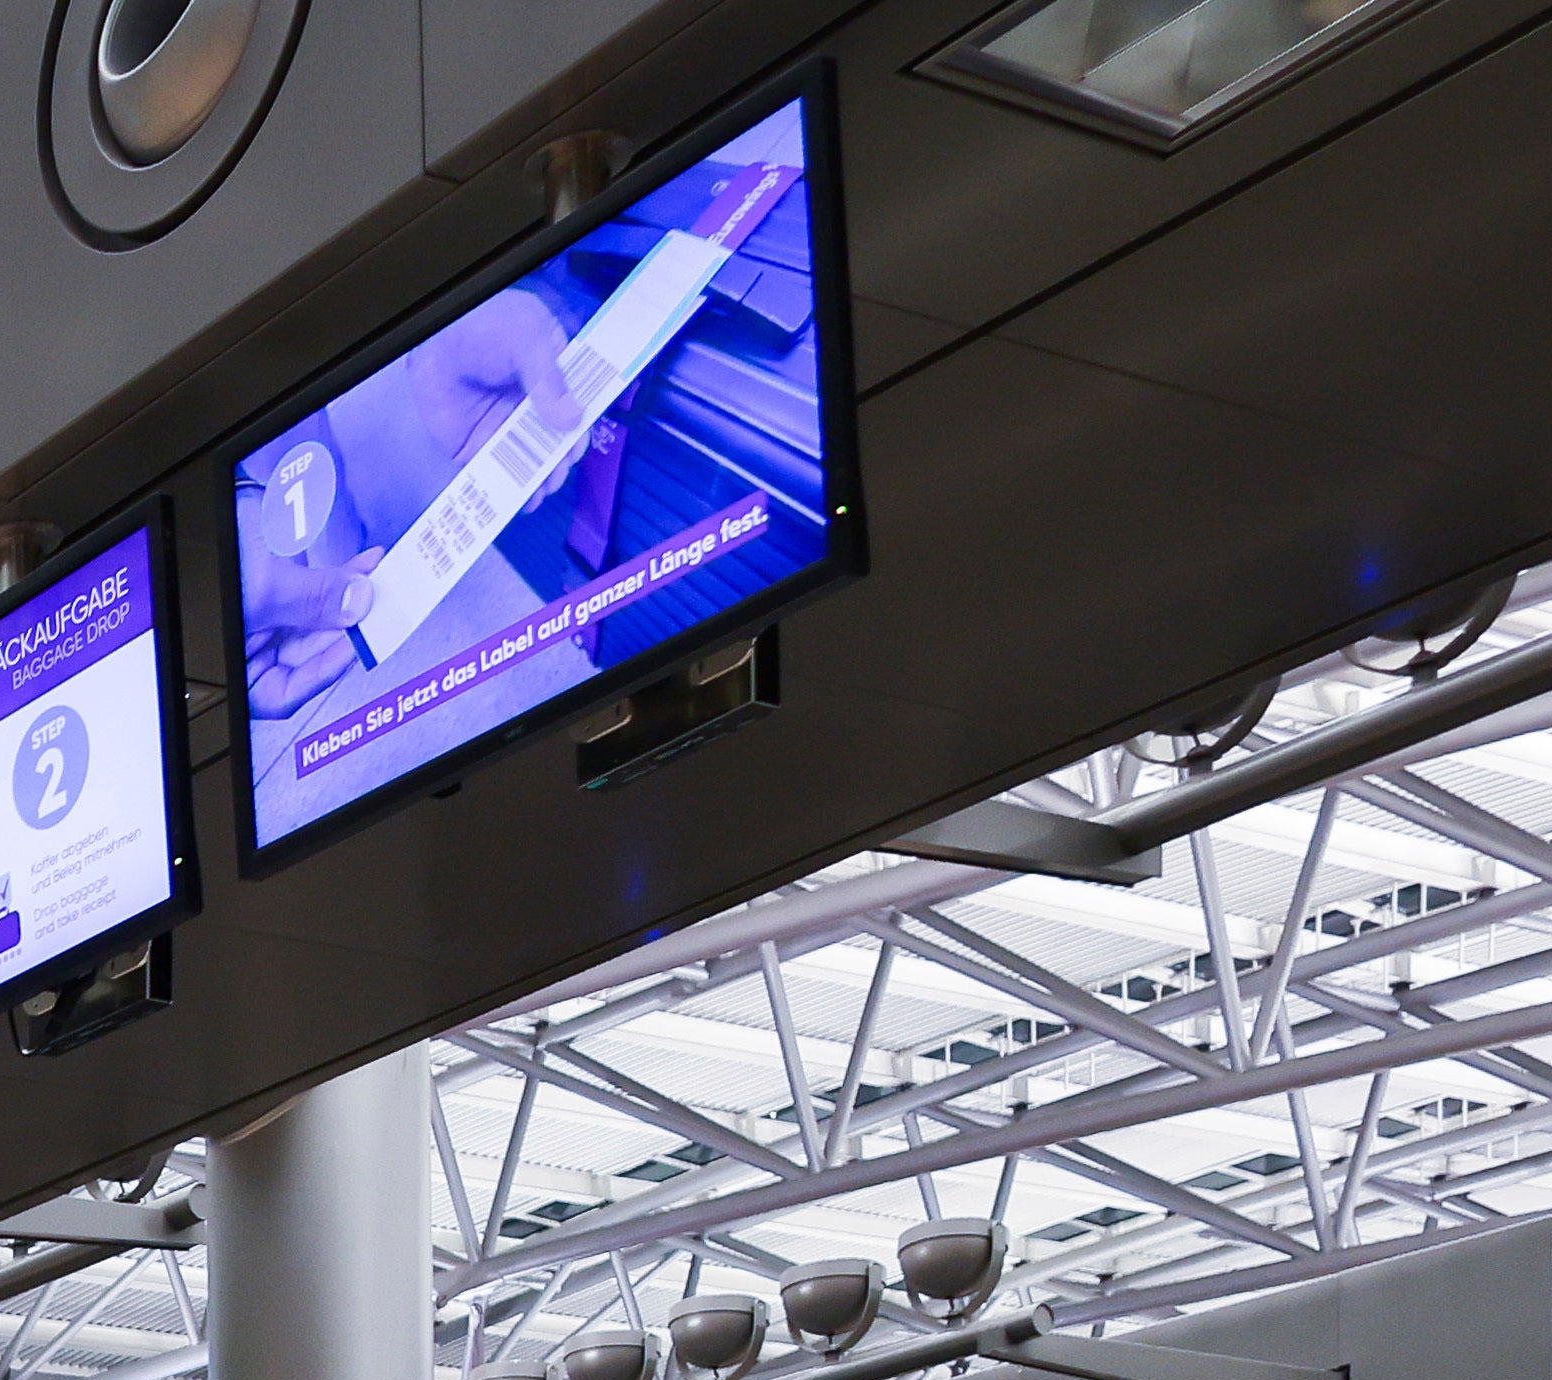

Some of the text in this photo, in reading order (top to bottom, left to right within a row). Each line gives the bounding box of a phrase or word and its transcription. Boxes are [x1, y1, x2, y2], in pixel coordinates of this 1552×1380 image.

[280, 451, 314, 486] STEP
[284, 480, 306, 541] 1
[13, 602, 131, 690] BAGGAGE DROP
[301, 505, 769, 768] Kleben Sie jetzt das Label auf ganzer Länge fest.
[31, 715, 66, 750] STEP
[34, 747, 67, 819] 2
[31, 825, 110, 878] Koffer abgeben
[32, 827, 142, 895] und Beleg mitnehmen
[33, 873, 110, 926] Drop baggage
[34, 888, 117, 942] and take receipt
